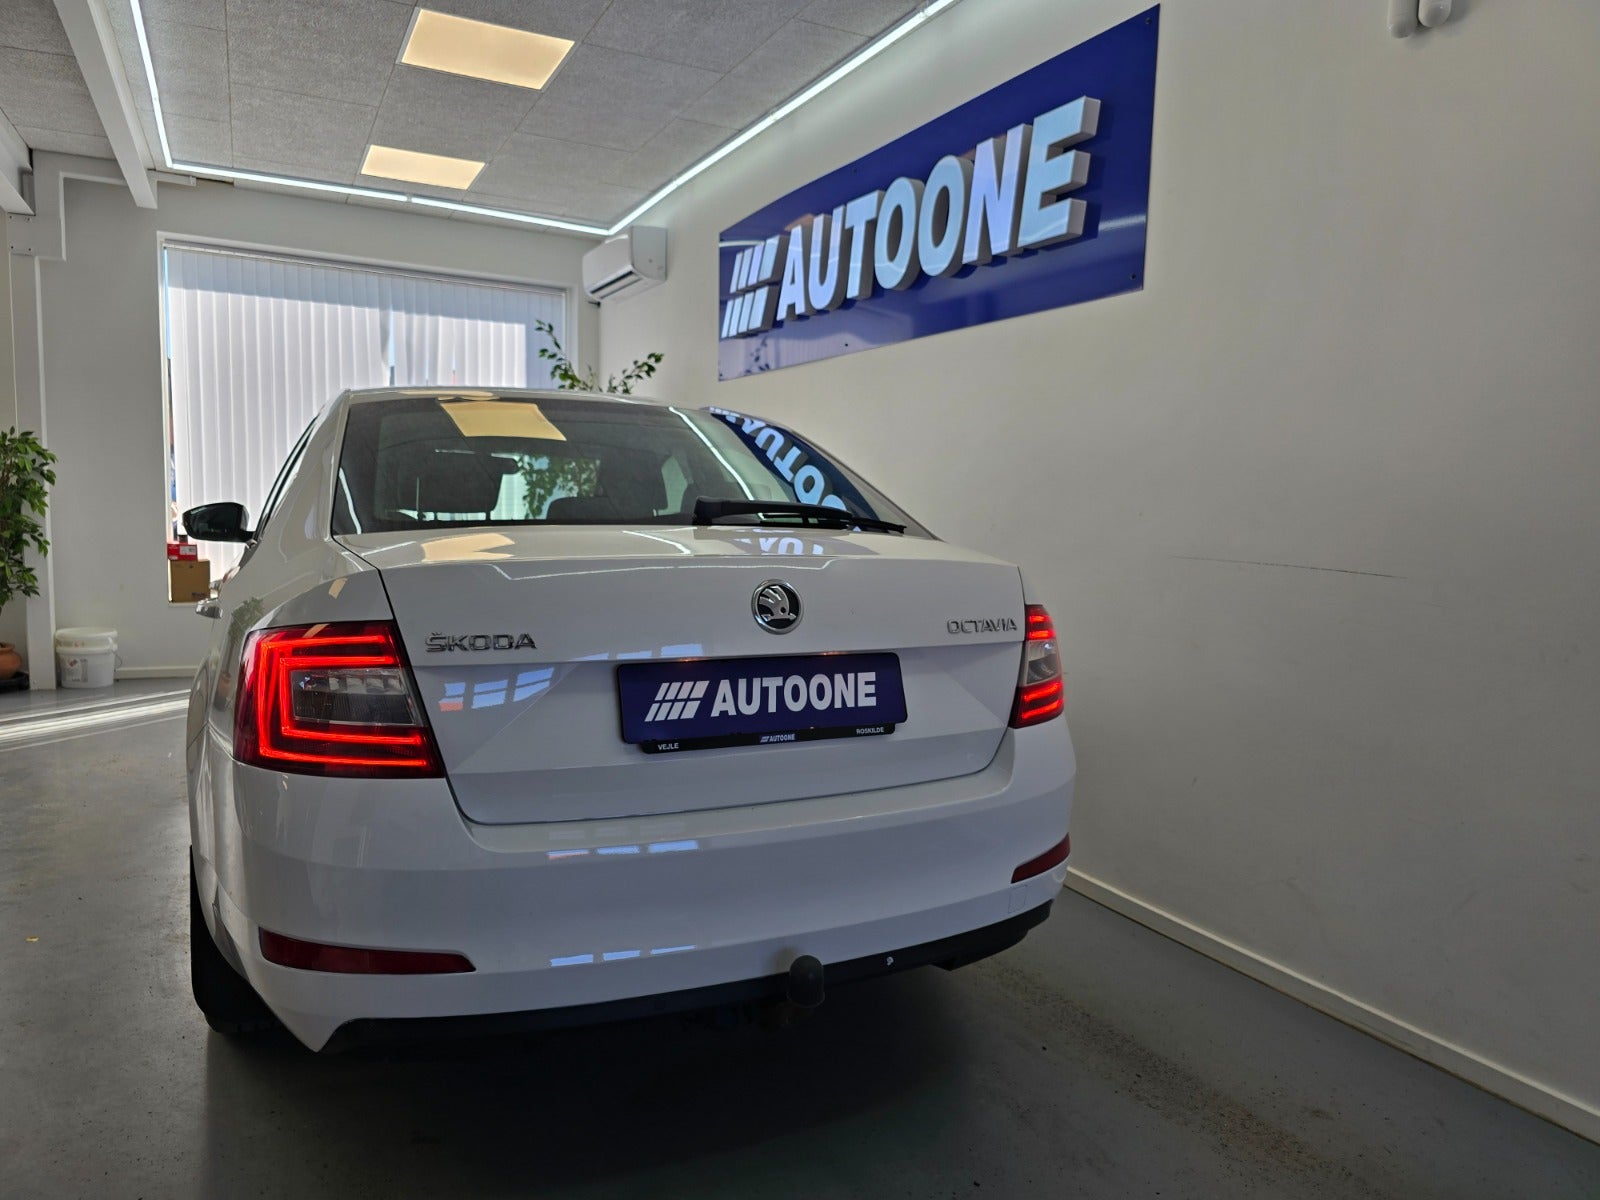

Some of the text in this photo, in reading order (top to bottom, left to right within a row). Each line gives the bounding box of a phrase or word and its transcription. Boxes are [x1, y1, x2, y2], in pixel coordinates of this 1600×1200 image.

[777, 96, 1101, 321] AUTOONE
[947, 618, 1017, 634] OCTAVIA
[425, 631, 537, 652] ŠKODA
[711, 672, 877, 717] AUTOONE
[769, 734, 796, 742] AUTOONE
[856, 727, 885, 735] ROSKILDE
[658, 742, 679, 750] VEJLE
